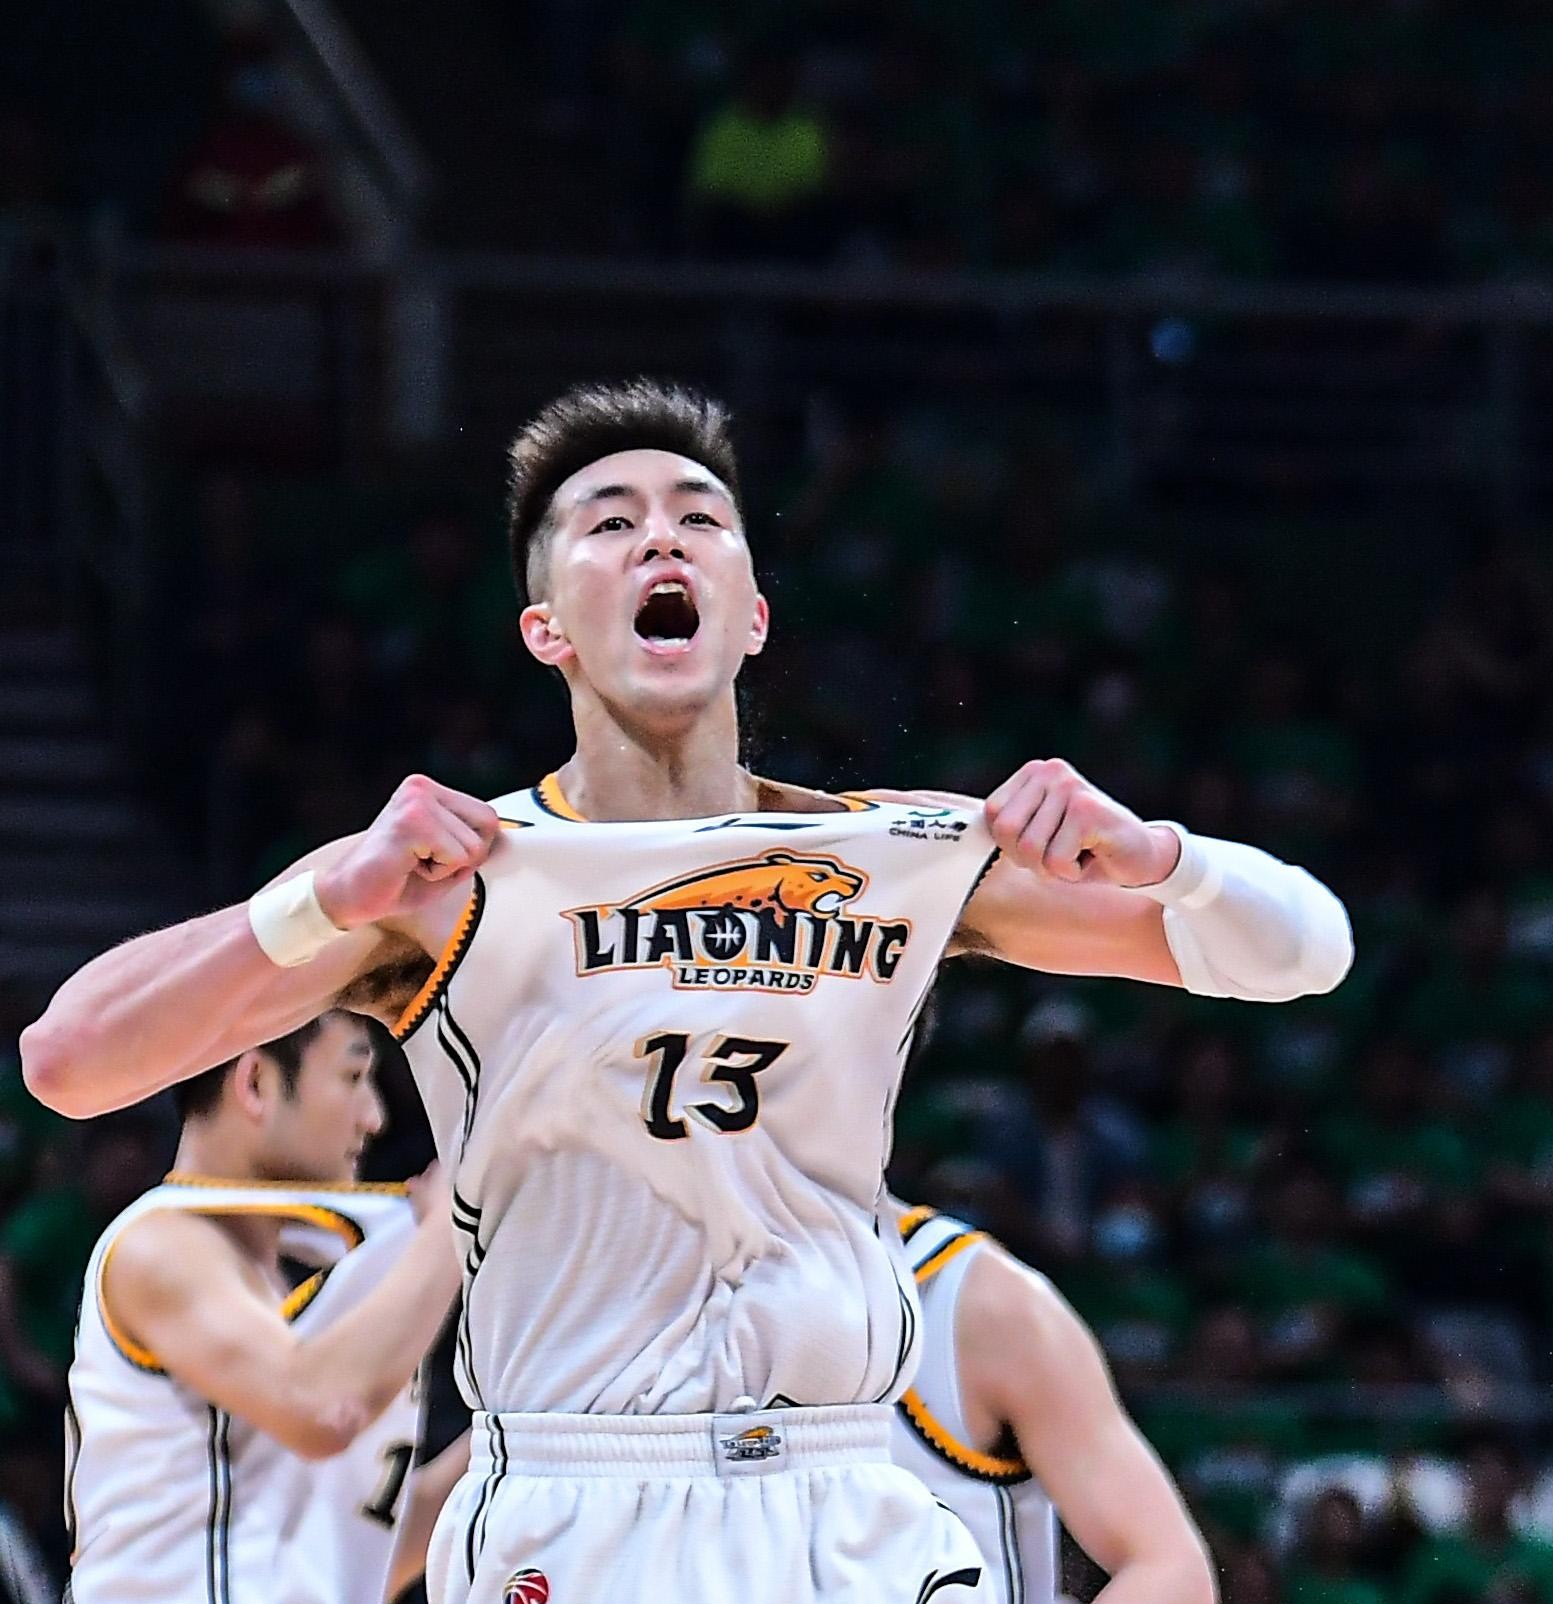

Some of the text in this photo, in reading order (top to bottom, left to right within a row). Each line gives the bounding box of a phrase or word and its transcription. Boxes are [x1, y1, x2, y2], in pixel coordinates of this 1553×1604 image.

[888, 826, 928, 840] CHINA
[570, 906, 911, 983] LIAONING
[677, 966, 816, 990] LEOPARDS
[634, 1030, 791, 1142] 13
